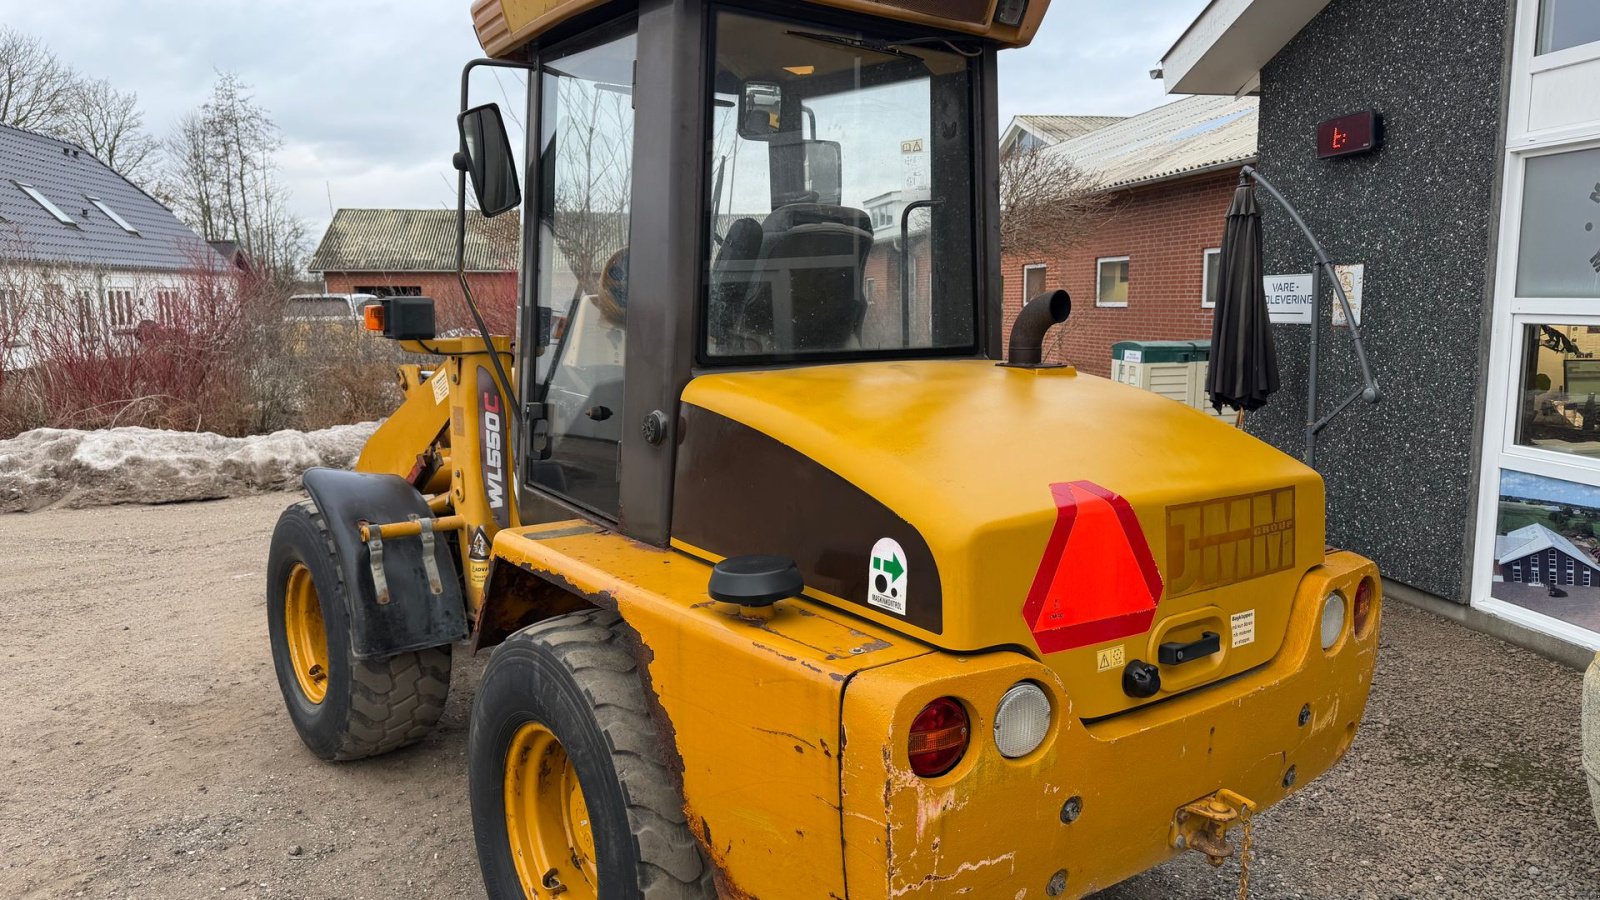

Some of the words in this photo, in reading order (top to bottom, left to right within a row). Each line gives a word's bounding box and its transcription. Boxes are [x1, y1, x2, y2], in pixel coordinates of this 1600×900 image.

[1264, 294, 1313, 305] DLEVERING
[485, 391, 503, 509] WL550C
[1253, 520, 1293, 535] GROUP
